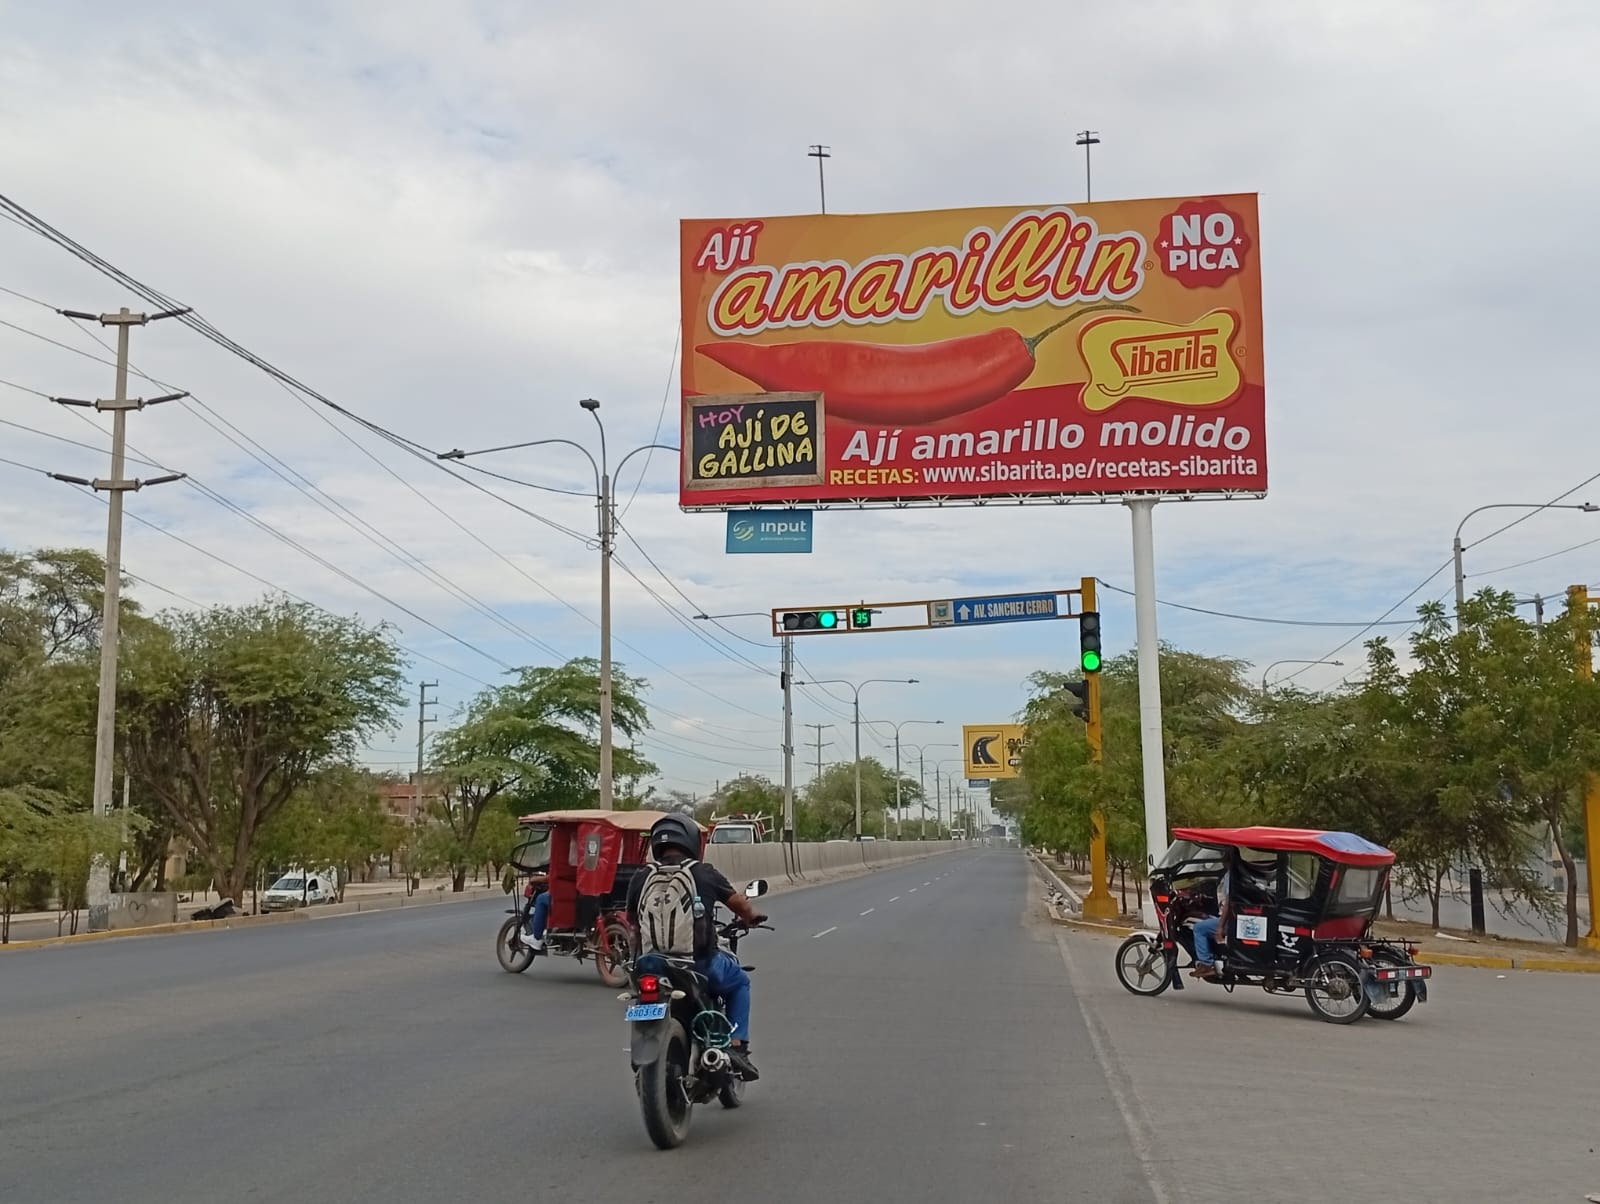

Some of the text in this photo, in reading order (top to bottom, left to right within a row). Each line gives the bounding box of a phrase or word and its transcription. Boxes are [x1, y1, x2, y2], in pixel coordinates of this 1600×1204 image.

[1171, 213, 1235, 247] NO
[697, 225, 759, 270] Ají
[1169, 247, 1240, 271] PICA
[711, 209, 1144, 331] amarillin
[1110, 328, 1219, 378] Sibarita
[698, 405, 745, 429] HOY
[718, 409, 809, 449] AJÍ DE
[841, 414, 1250, 467] Ají amarillo molido
[698, 437, 813, 479] GALLINA
[829, 455, 1258, 485] RECETAS: www.sibarita.pe/recetas-sibarita
[760, 520, 807, 536] input
[856, 612, 868, 624] 35
[973, 599, 1054, 618] AV. SANCHEZ CERRO
